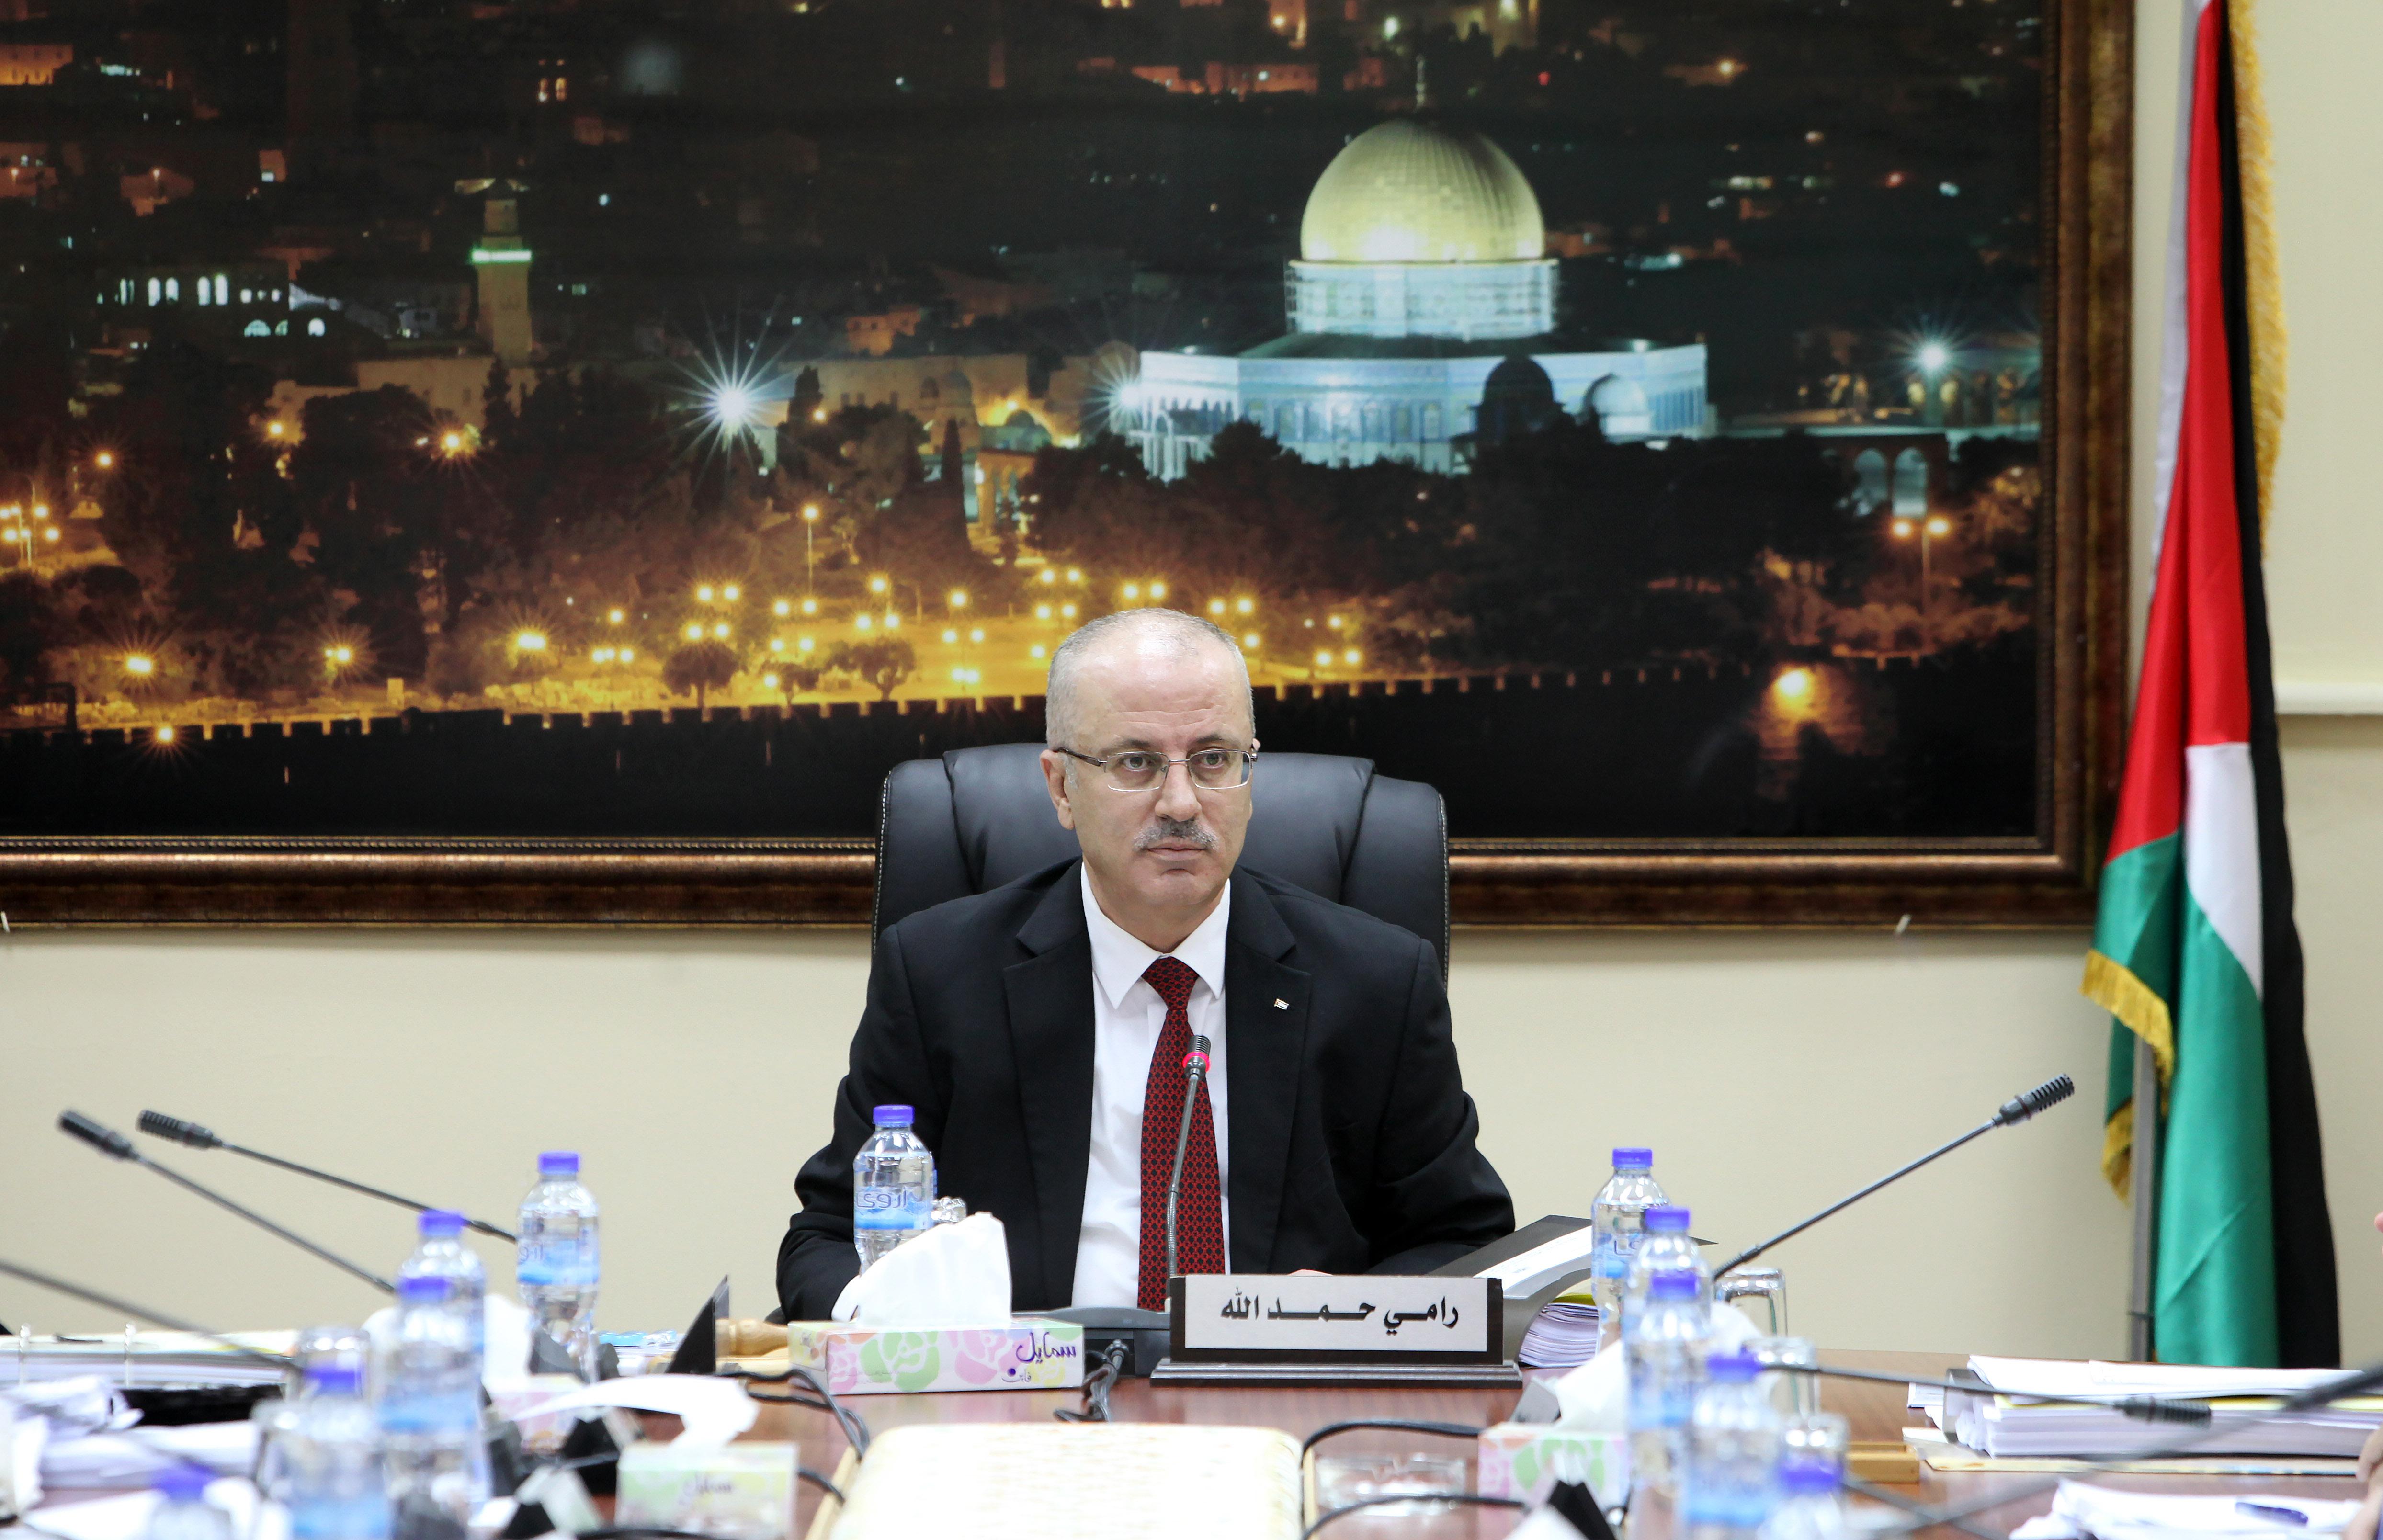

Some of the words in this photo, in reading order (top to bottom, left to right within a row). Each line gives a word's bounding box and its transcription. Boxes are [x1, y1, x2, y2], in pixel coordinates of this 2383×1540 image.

[1220, 1286, 1260, 1320] الله
[1267, 1297, 1376, 1321] حمد
[1383, 1296, 1459, 1336] رامي
[1015, 1331, 1077, 1364] سمايل
